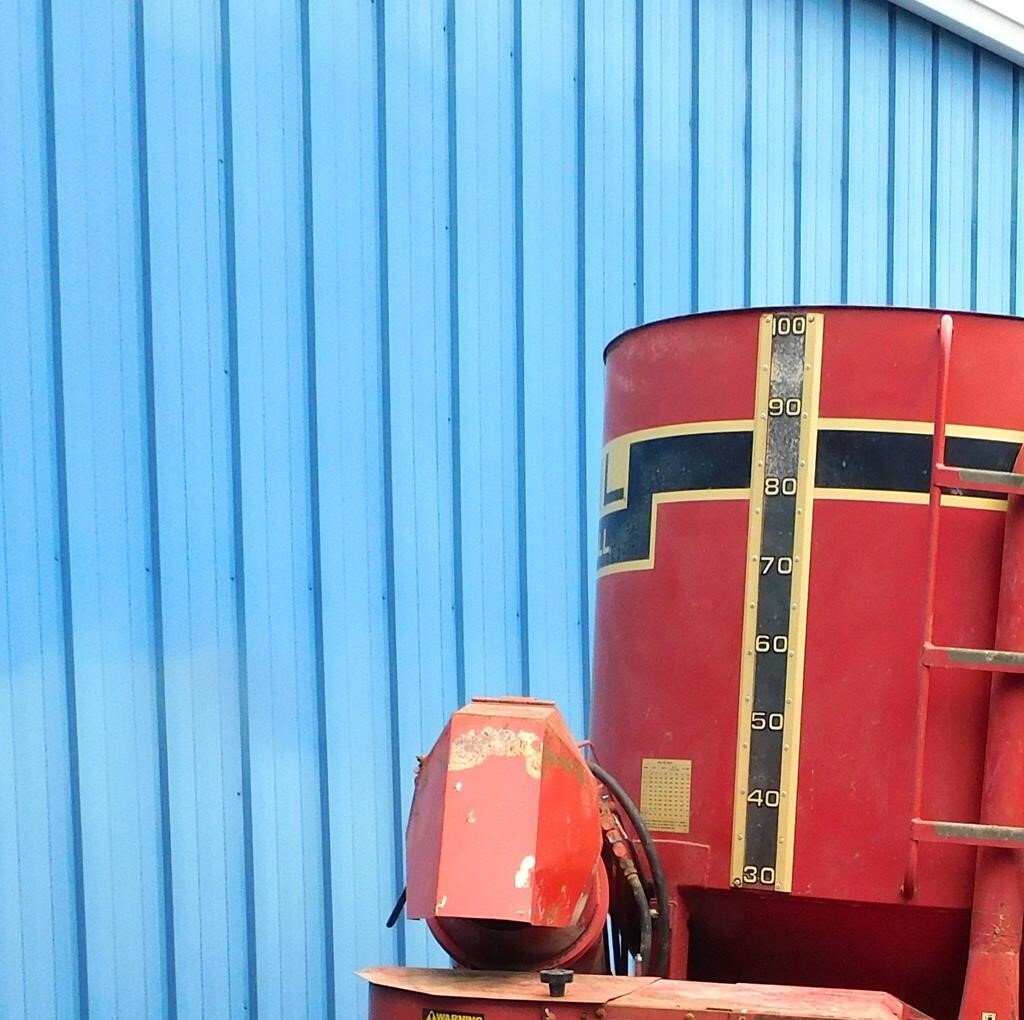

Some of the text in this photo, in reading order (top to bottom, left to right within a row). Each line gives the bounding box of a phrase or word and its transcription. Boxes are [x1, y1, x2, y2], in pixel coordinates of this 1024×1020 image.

[772, 317, 806, 336] 100
[768, 398, 802, 417] 90
[764, 477, 797, 496] 80
[760, 556, 793, 575] 70
[754, 634, 789, 653] 60
[751, 712, 784, 731] 50
[747, 789, 780, 808] 40
[742, 866, 776, 884] 30
